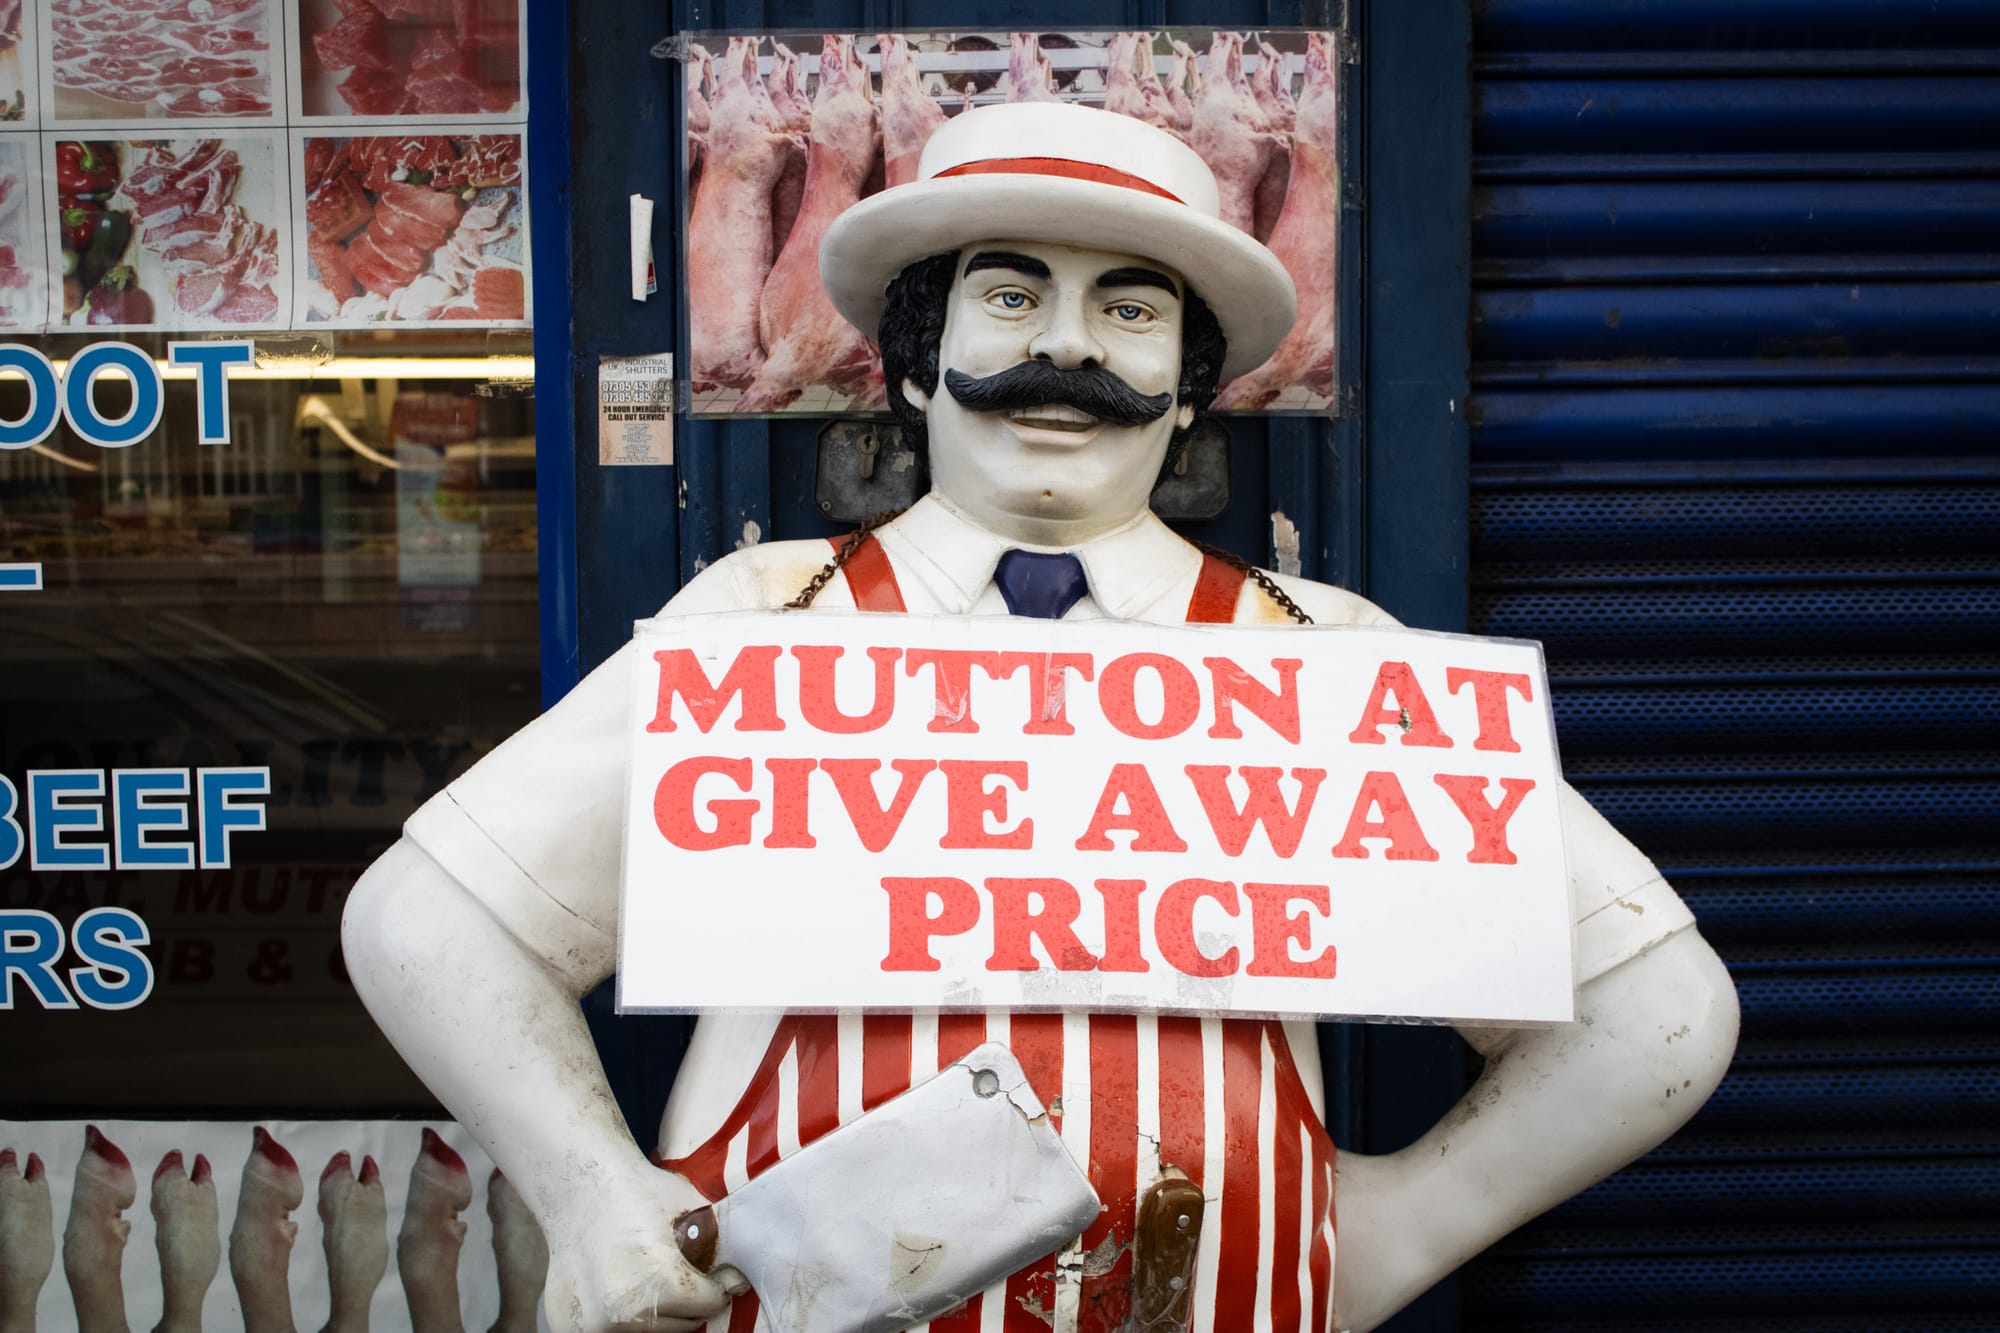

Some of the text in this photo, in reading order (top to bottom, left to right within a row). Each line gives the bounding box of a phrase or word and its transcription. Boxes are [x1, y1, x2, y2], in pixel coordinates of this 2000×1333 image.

[625, 359, 667, 367] INDUSTRIAL
[625, 367, 668, 375] SHUTTERS
[602, 381, 632, 392] 07305
[633, 381, 651, 392] 453
[602, 392, 632, 403] 07305
[633, 392, 651, 403] 485
[632, 405, 671, 413] EMERGENCY
[646, 645, 1534, 753] MUTTON AT
[654, 756, 1536, 865] GIVE AWAY
[0, 766, 271, 872] EEF
[880, 877, 1337, 979] PRICE
